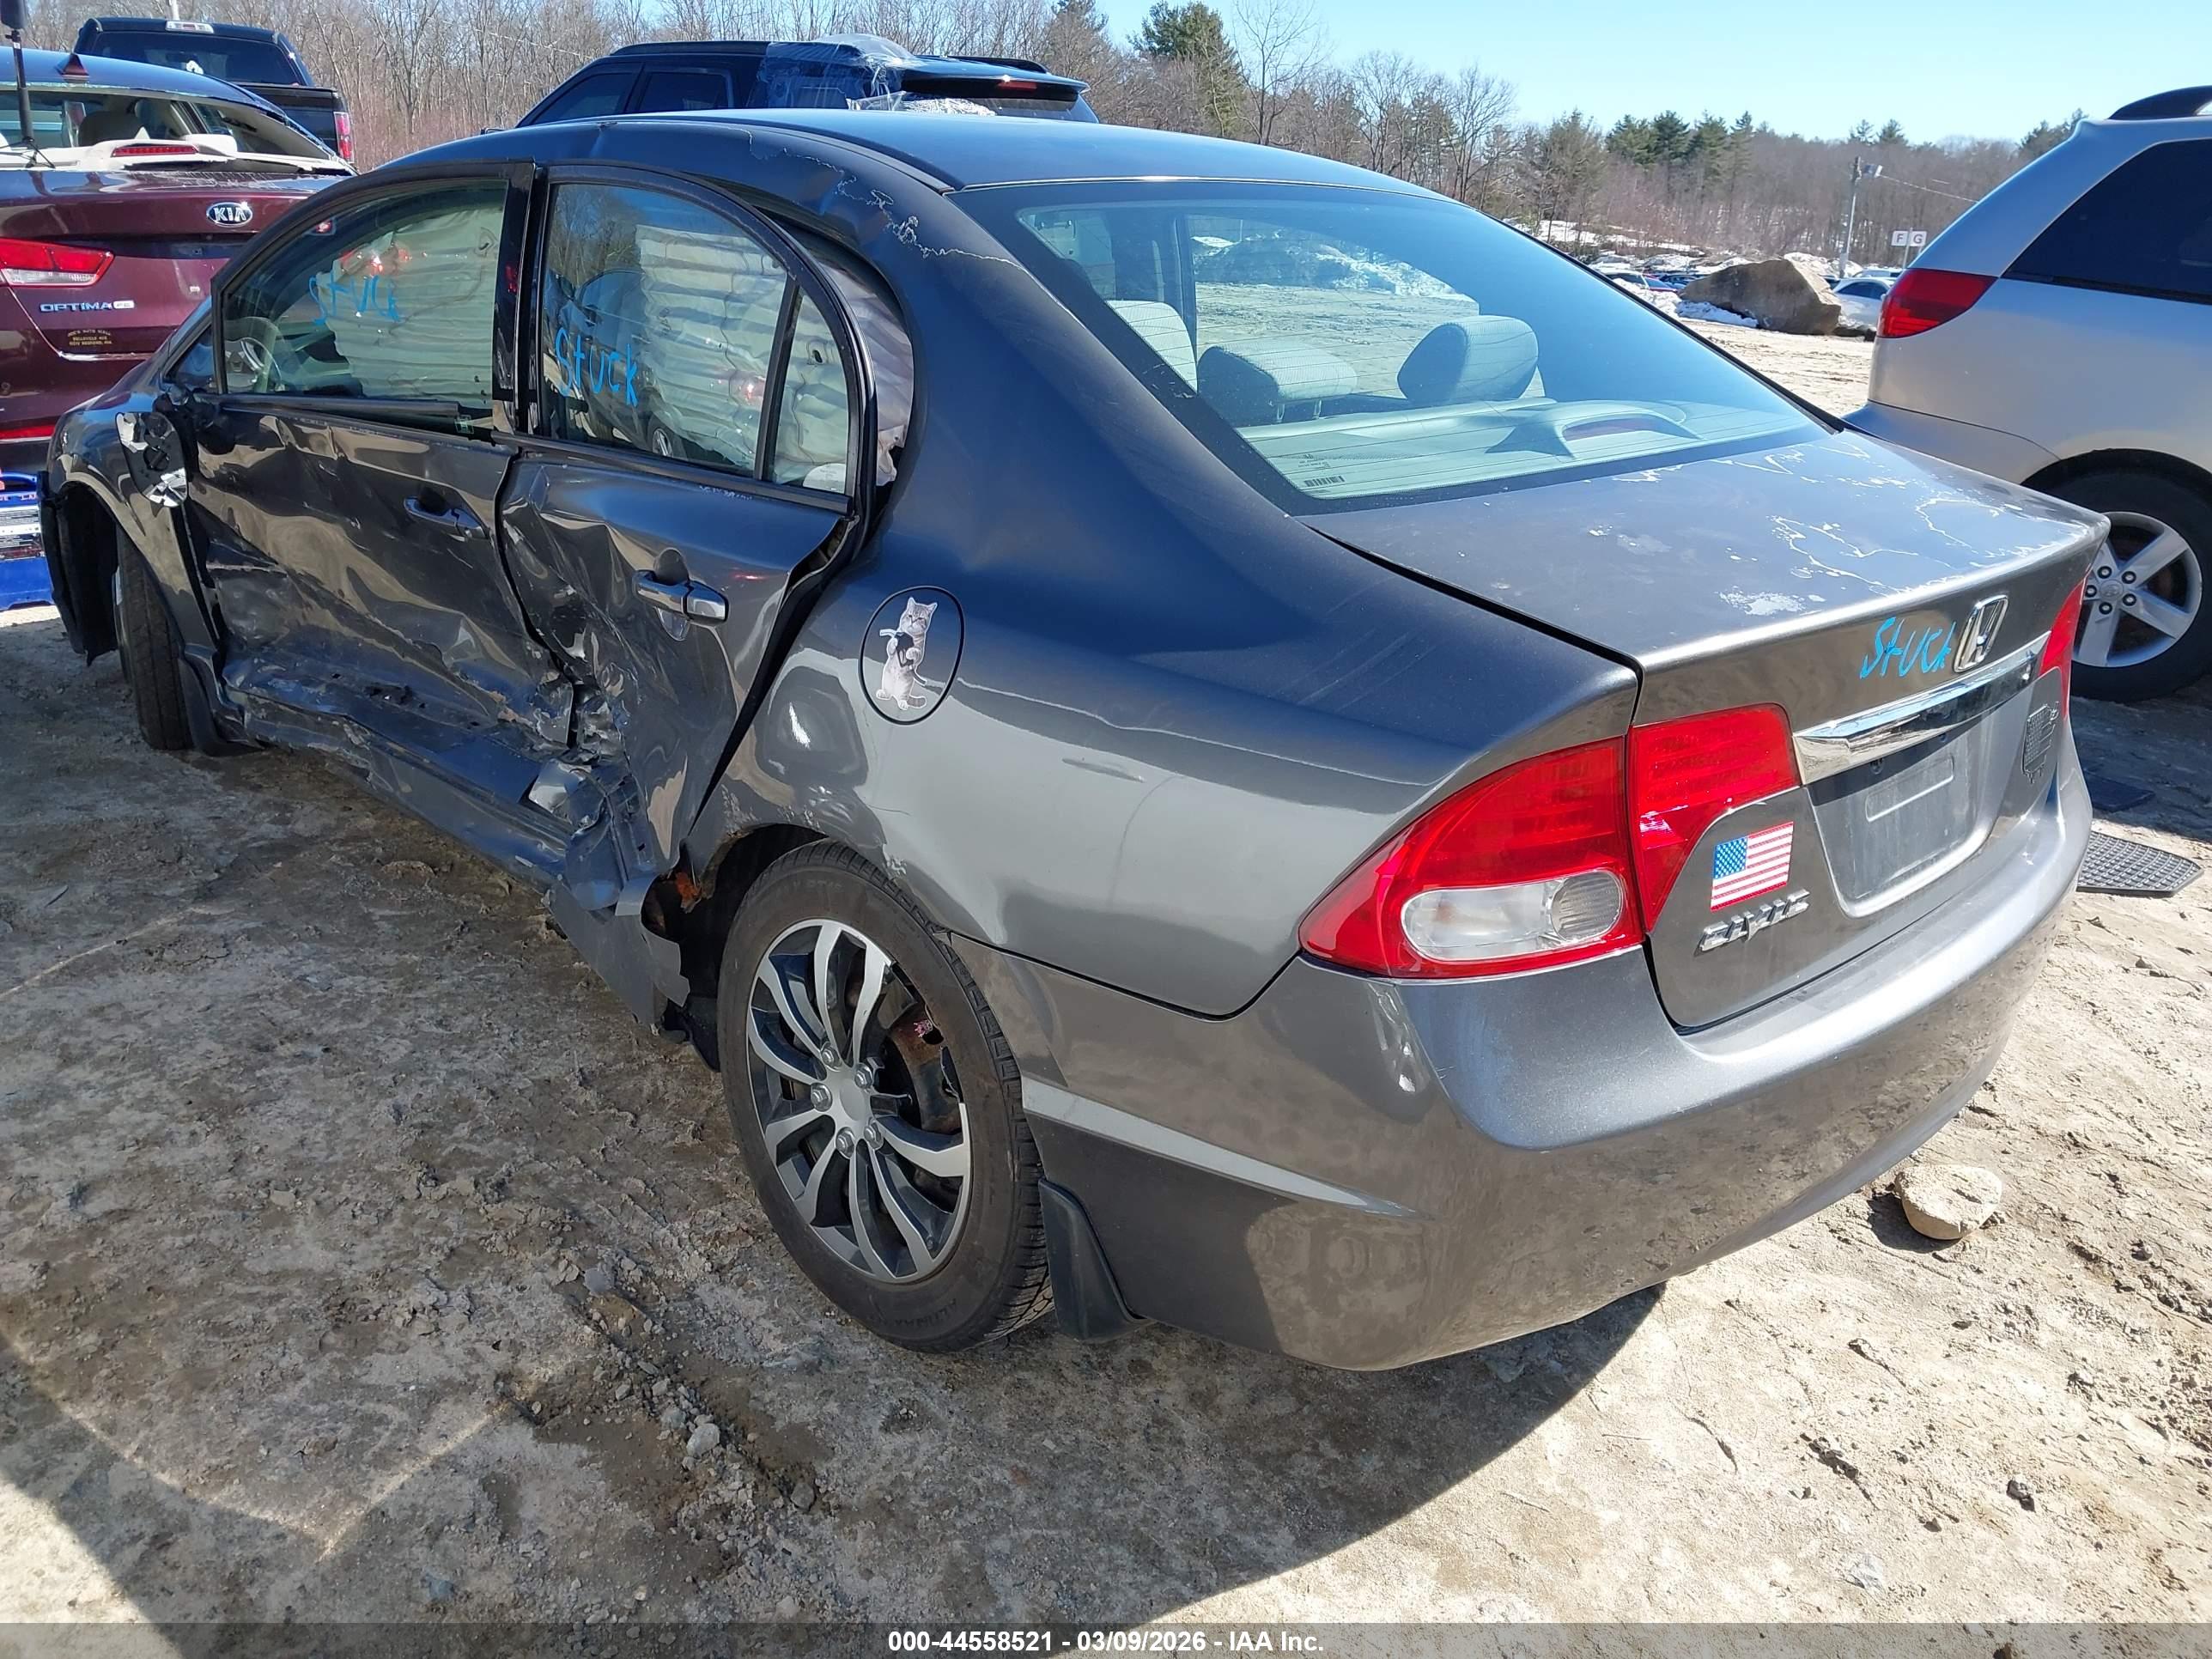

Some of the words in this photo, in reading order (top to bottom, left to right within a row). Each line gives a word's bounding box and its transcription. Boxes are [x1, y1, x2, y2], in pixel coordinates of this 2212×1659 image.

[214, 207, 247, 222] KIA
[1896, 233, 1904, 243] F
[1913, 234, 1923, 244] G
[40, 301, 112, 312] OPTIMA
[1698, 889, 1810, 952] CIVIC
